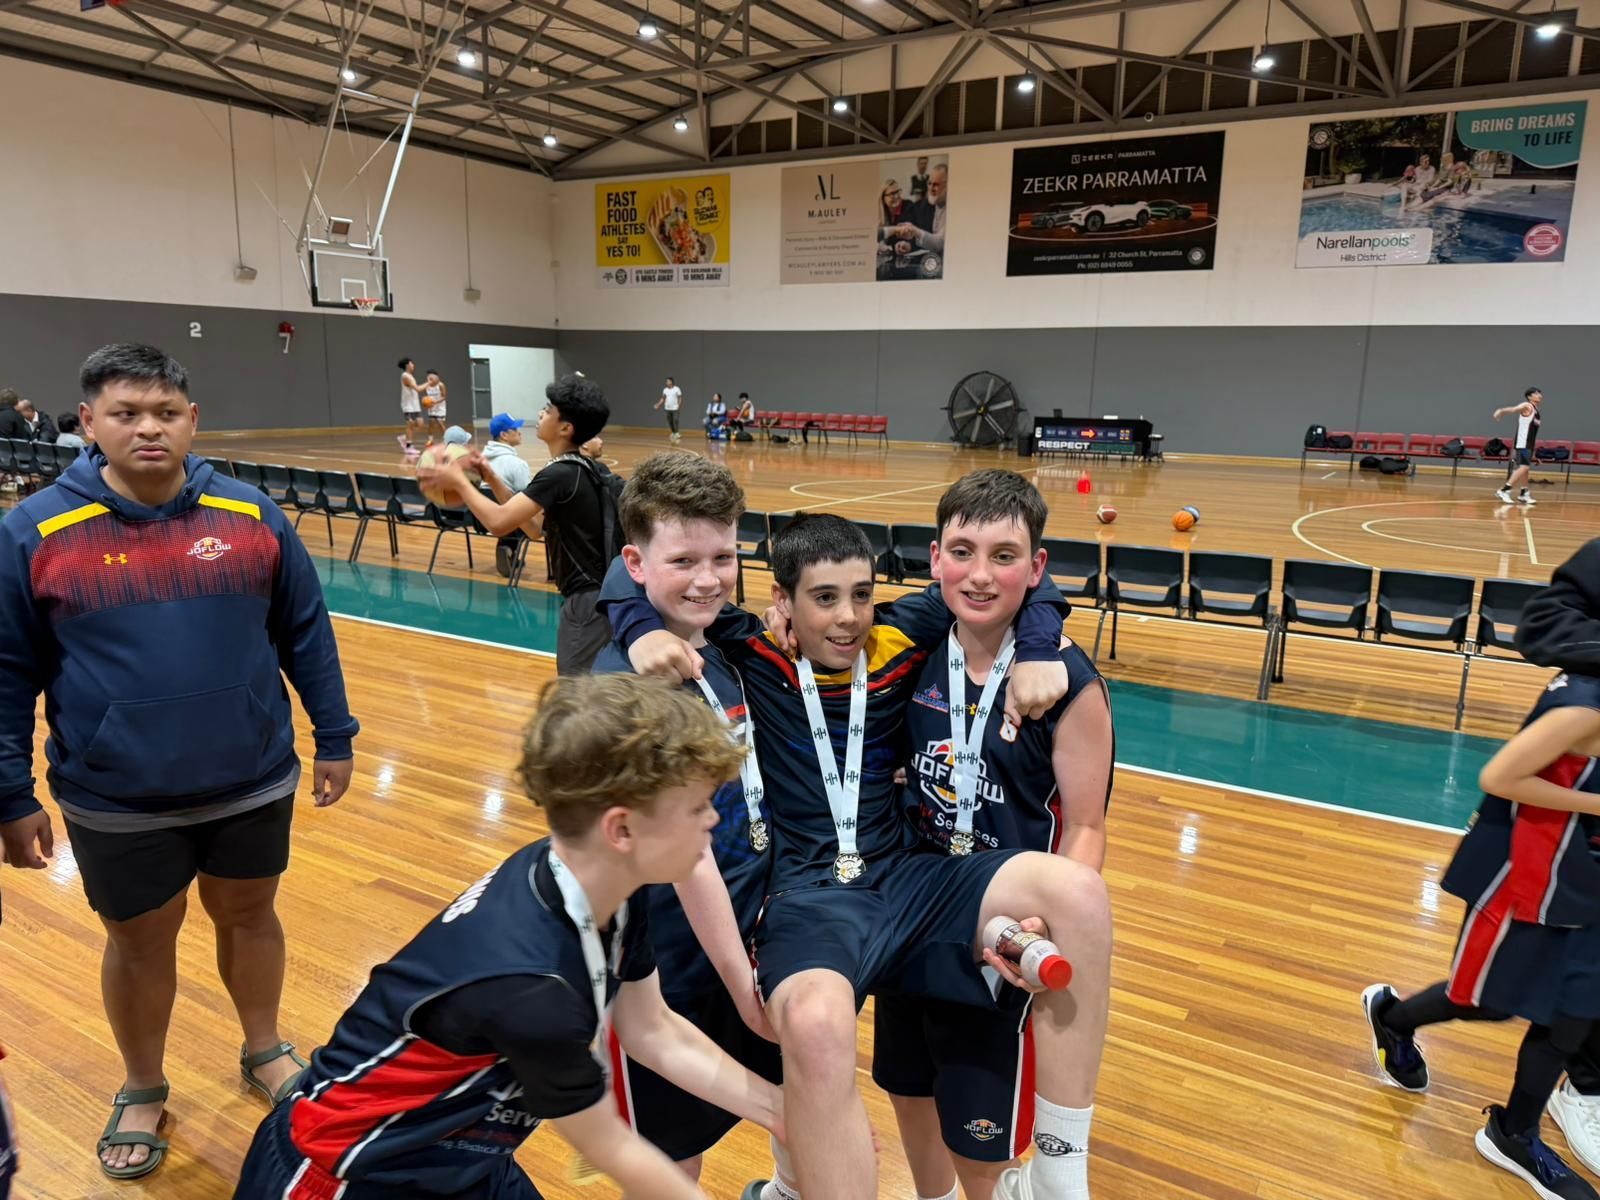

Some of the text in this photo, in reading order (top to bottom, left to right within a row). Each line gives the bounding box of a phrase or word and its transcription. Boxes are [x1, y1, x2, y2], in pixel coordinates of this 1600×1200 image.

[1472, 113, 1576, 134] BRING DREAMS
[1523, 131, 1574, 147] TO LIFE
[1082, 150, 1156, 162] ZEEKR PARRAMATTA
[1022, 166, 1208, 194] ZEEKR PARRAMATTA
[607, 191, 637, 208] FAST
[608, 208, 638, 223] FOOD
[602, 223, 646, 237] ATHLETES
[618, 236, 628, 244] SAY
[607, 245, 640, 258] YES TO!
[1118, 251, 1139, 259] Church
[1149, 250, 1183, 258] Parramatta
[1340, 253, 1386, 263] Hills District
[190, 322, 202, 337] 2
[1038, 441, 1090, 450] RESPECT
[187, 544, 232, 556] JOFLOW
[934, 813, 999, 848] Seces
[964, 1122, 1003, 1136] JOFLOW
